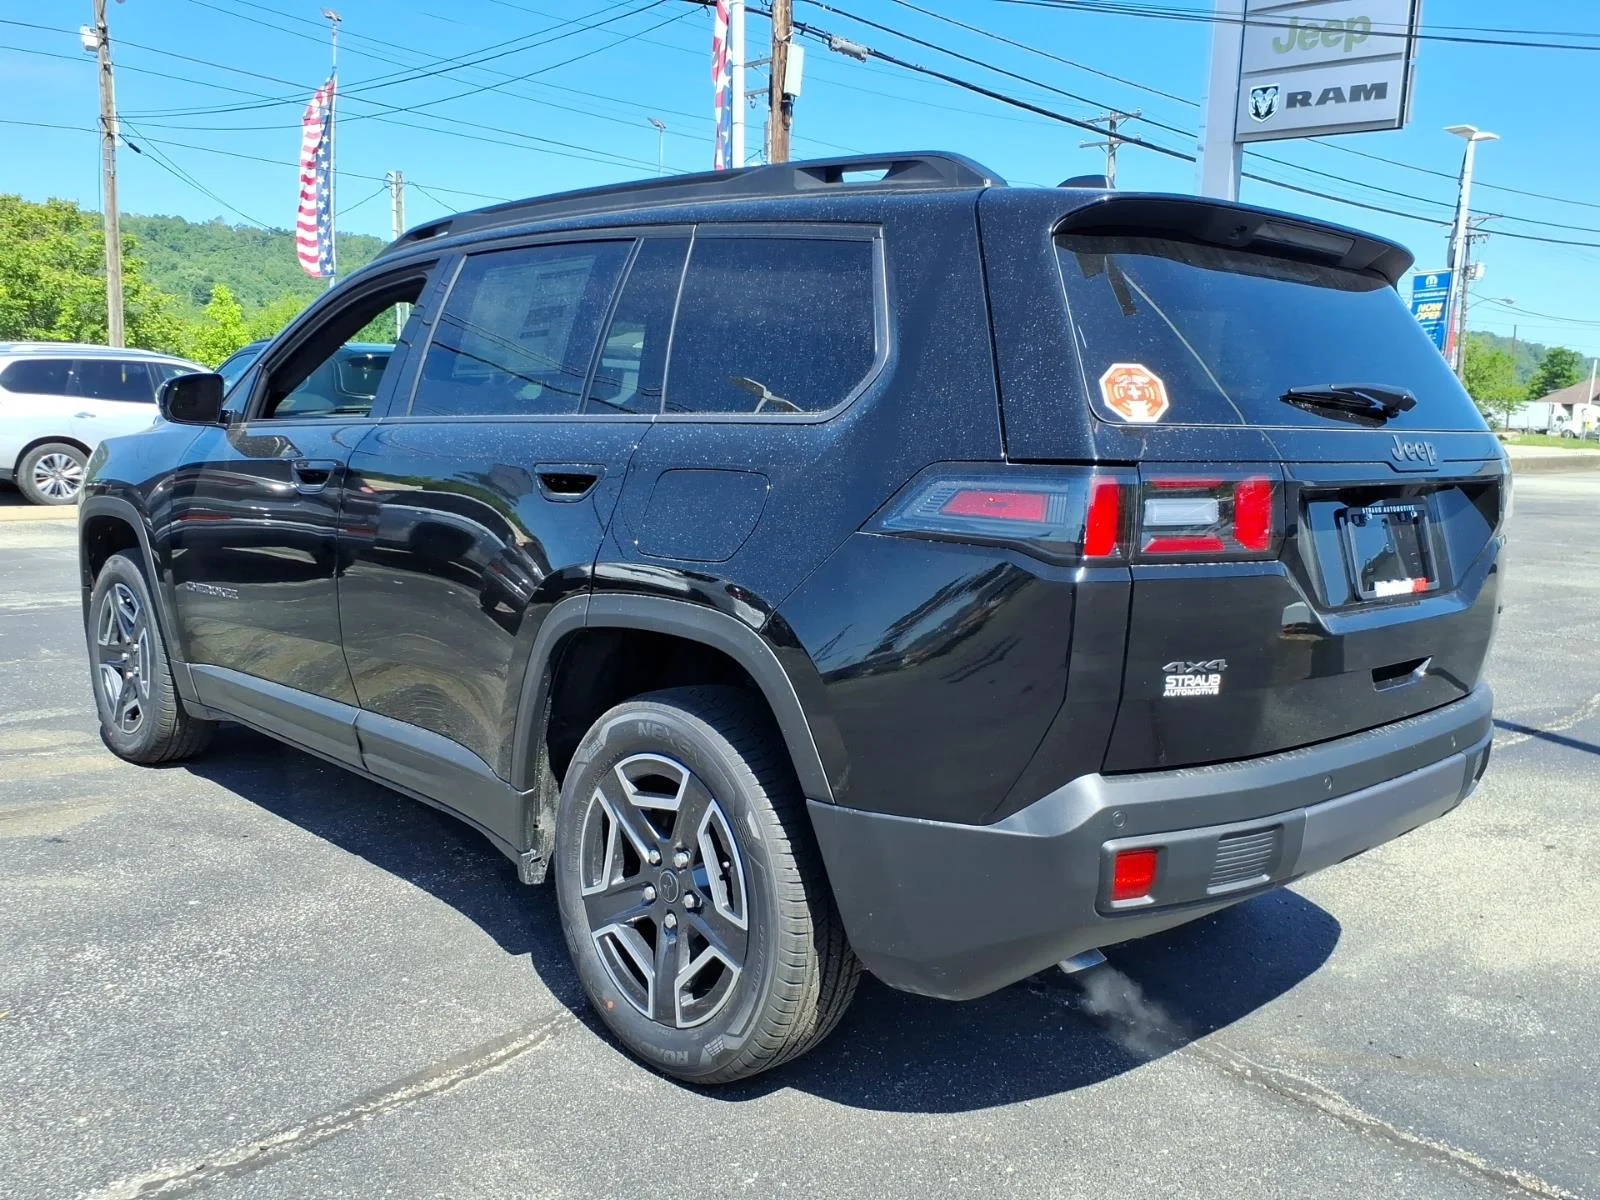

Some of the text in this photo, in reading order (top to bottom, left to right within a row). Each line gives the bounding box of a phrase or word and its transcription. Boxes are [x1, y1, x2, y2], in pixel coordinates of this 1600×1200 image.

[1272, 15, 1371, 54] Jeep
[1286, 82, 1388, 109] RAM
[1391, 434, 1437, 466] Jeep
[1163, 687, 1220, 697] AUTOMOTIVE
[1165, 673, 1221, 687] STRAUB
